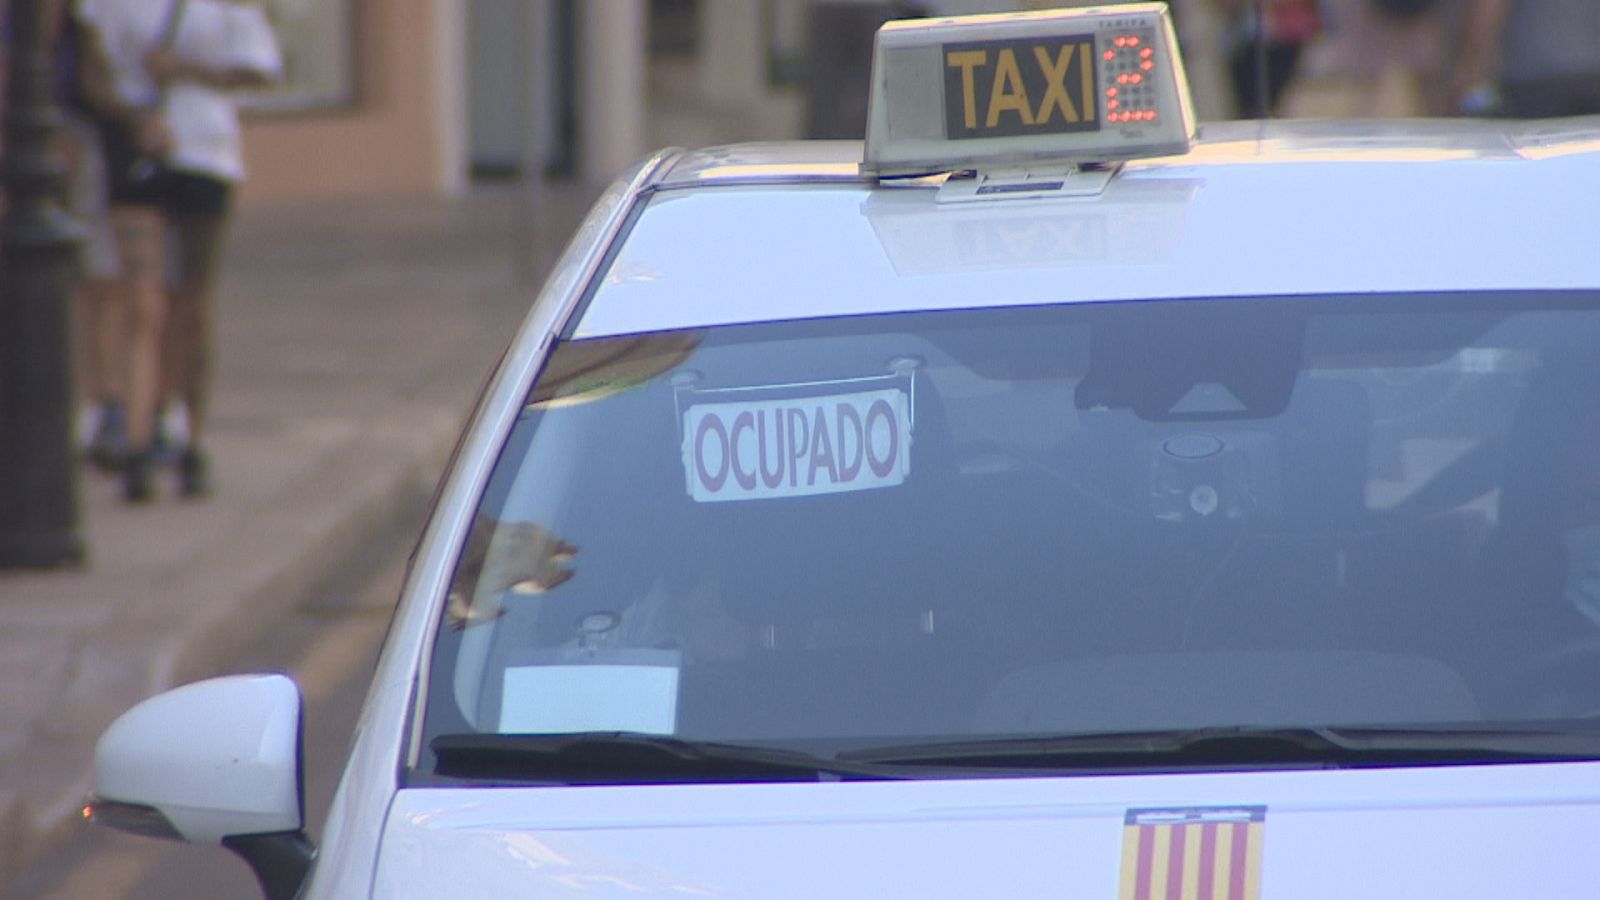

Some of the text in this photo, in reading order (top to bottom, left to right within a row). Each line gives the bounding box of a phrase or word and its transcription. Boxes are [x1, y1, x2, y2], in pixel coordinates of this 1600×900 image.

[947, 43, 1095, 128] TAXI
[1104, 36, 1156, 123] 2
[695, 399, 898, 492] OCUPADO
